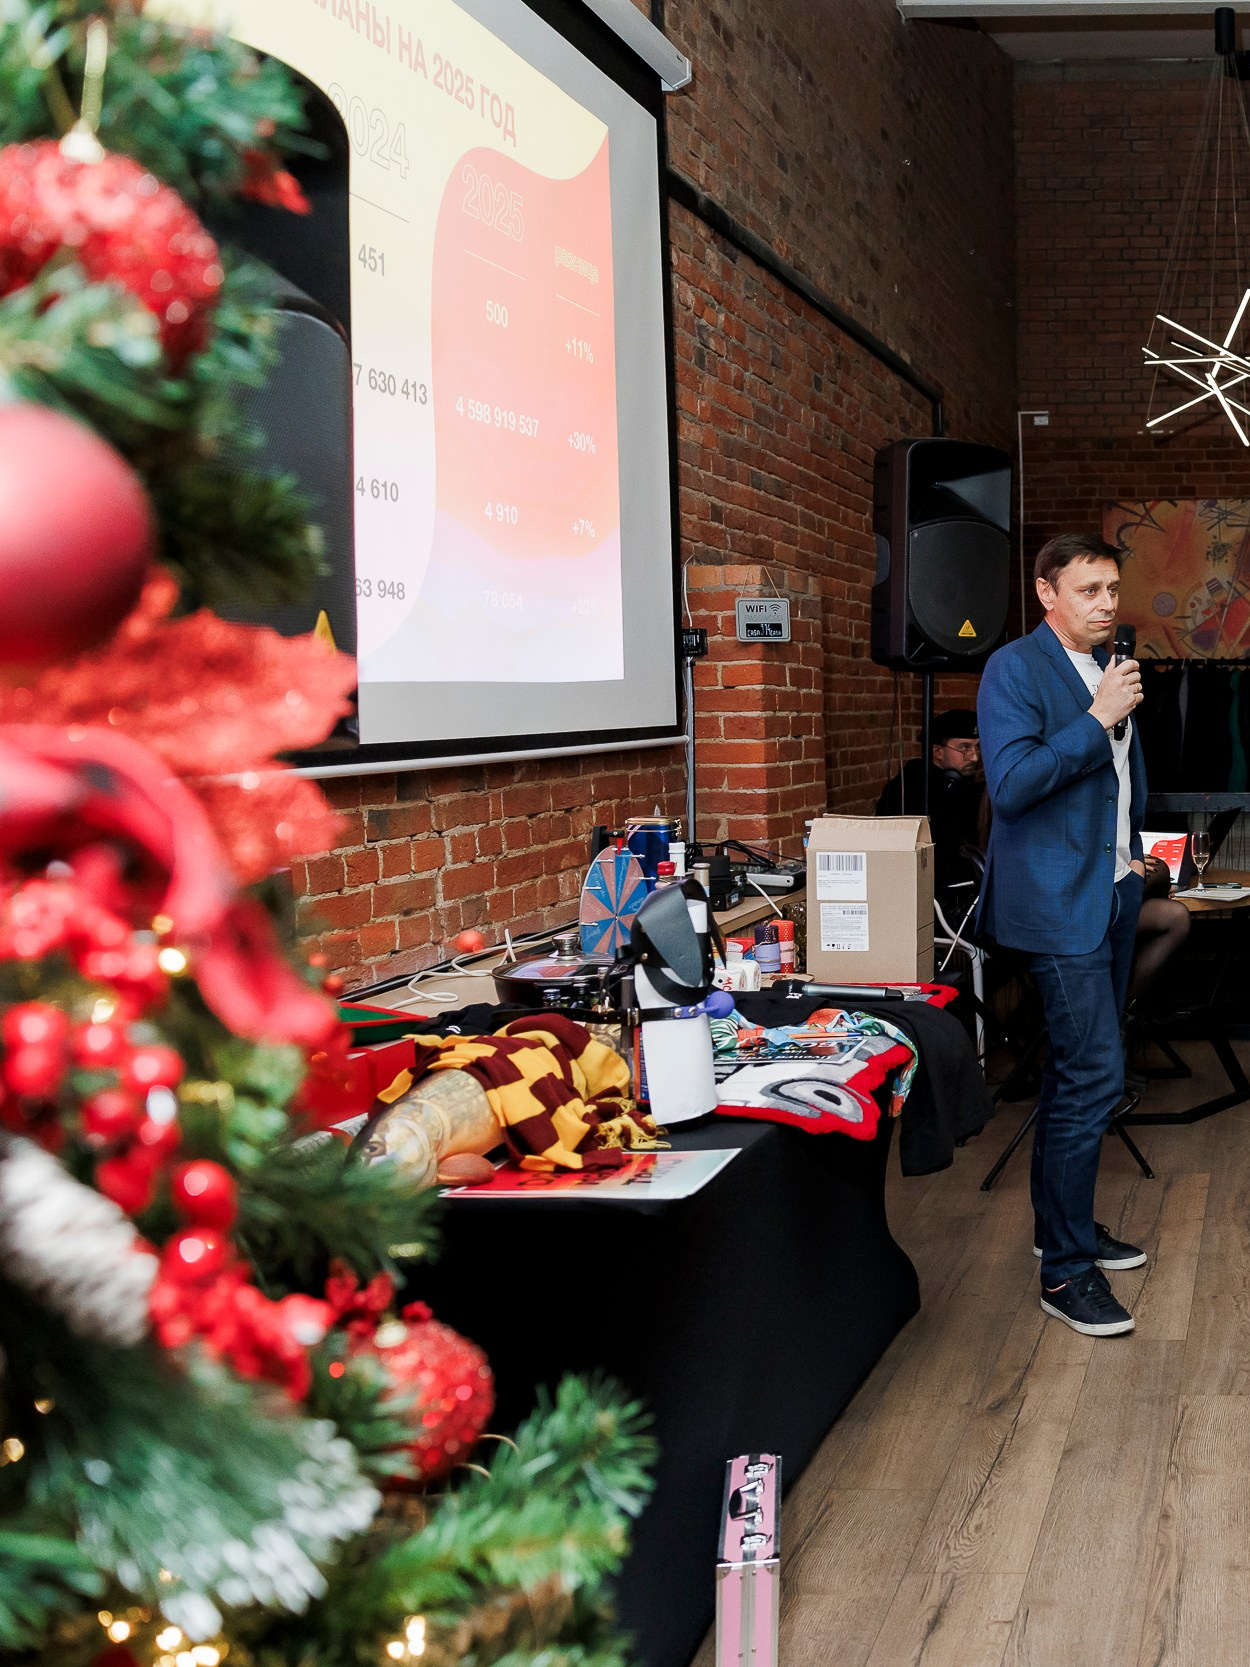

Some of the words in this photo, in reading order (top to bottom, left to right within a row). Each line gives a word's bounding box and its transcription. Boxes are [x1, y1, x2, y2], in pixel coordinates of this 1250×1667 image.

[314, 0, 391, 54] АНЫ
[398, 25, 428, 80] НА
[433, 52, 475, 110] 2025
[480, 84, 517, 148] ГОД
[462, 163, 525, 242] 2025
[358, 244, 386, 277] 451
[486, 299, 508, 328] 500
[565, 337, 594, 364] +11%
[368, 368, 396, 397] 630
[401, 378, 428, 405] 413
[455, 396, 464, 417] 4
[468, 399, 491, 426] 598
[494, 406, 516, 431] 919
[519, 412, 539, 438] 537
[567, 431, 596, 455] +30%
[371, 479, 399, 503] 610
[496, 503, 518, 524] 910
[572, 519, 595, 539] +7%
[378, 580, 405, 601] 948
[745, 604, 767, 613] WIFI
